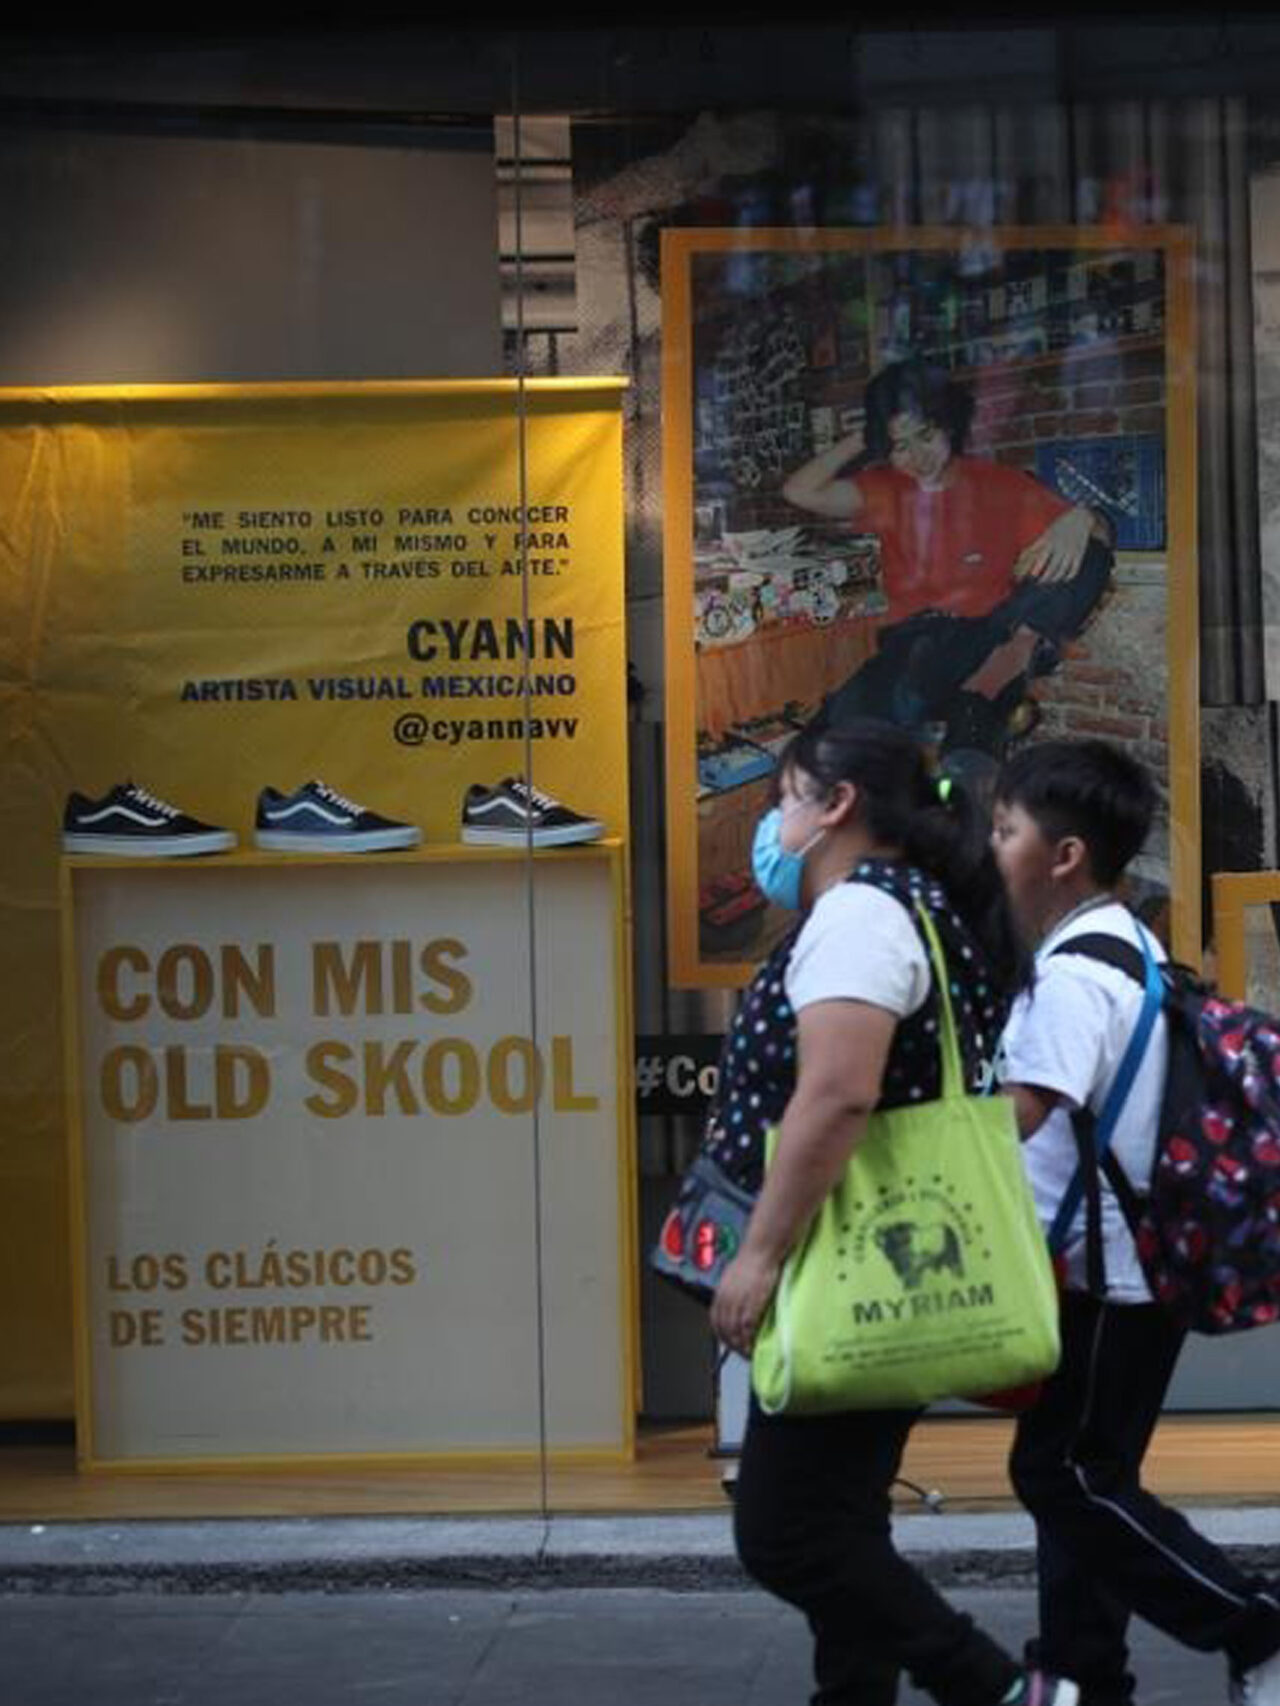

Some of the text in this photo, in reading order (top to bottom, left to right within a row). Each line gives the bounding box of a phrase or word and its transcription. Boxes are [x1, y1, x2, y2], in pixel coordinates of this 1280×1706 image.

[239, 511, 312, 529] SIENTO
[326, 509, 384, 528] LISTO
[399, 508, 453, 526] PARA
[467, 505, 569, 524] CONOCER
[182, 538, 206, 557] EL
[322, 535, 336, 553] A
[353, 534, 377, 554] MI
[395, 533, 467, 552] MISMO
[484, 533, 498, 551] Y
[514, 531, 569, 550] PARA
[182, 562, 326, 584] EXPRESARME
[336, 563, 350, 581] A
[451, 558, 491, 578] DEL
[407, 616, 574, 662] CYANN
[181, 674, 577, 703] ARTISTA VISUAL MEXICANO
[393, 711, 579, 746] @cyannavv
[97, 938, 475, 1022] CON MIS
[101, 1034, 599, 1122] OLD SKOOL
[107, 1237, 417, 1292] LOS CLÁSICOS
[853, 1284, 995, 1325] MYRIAM
[110, 1304, 374, 1348] DE SIEMPRE
